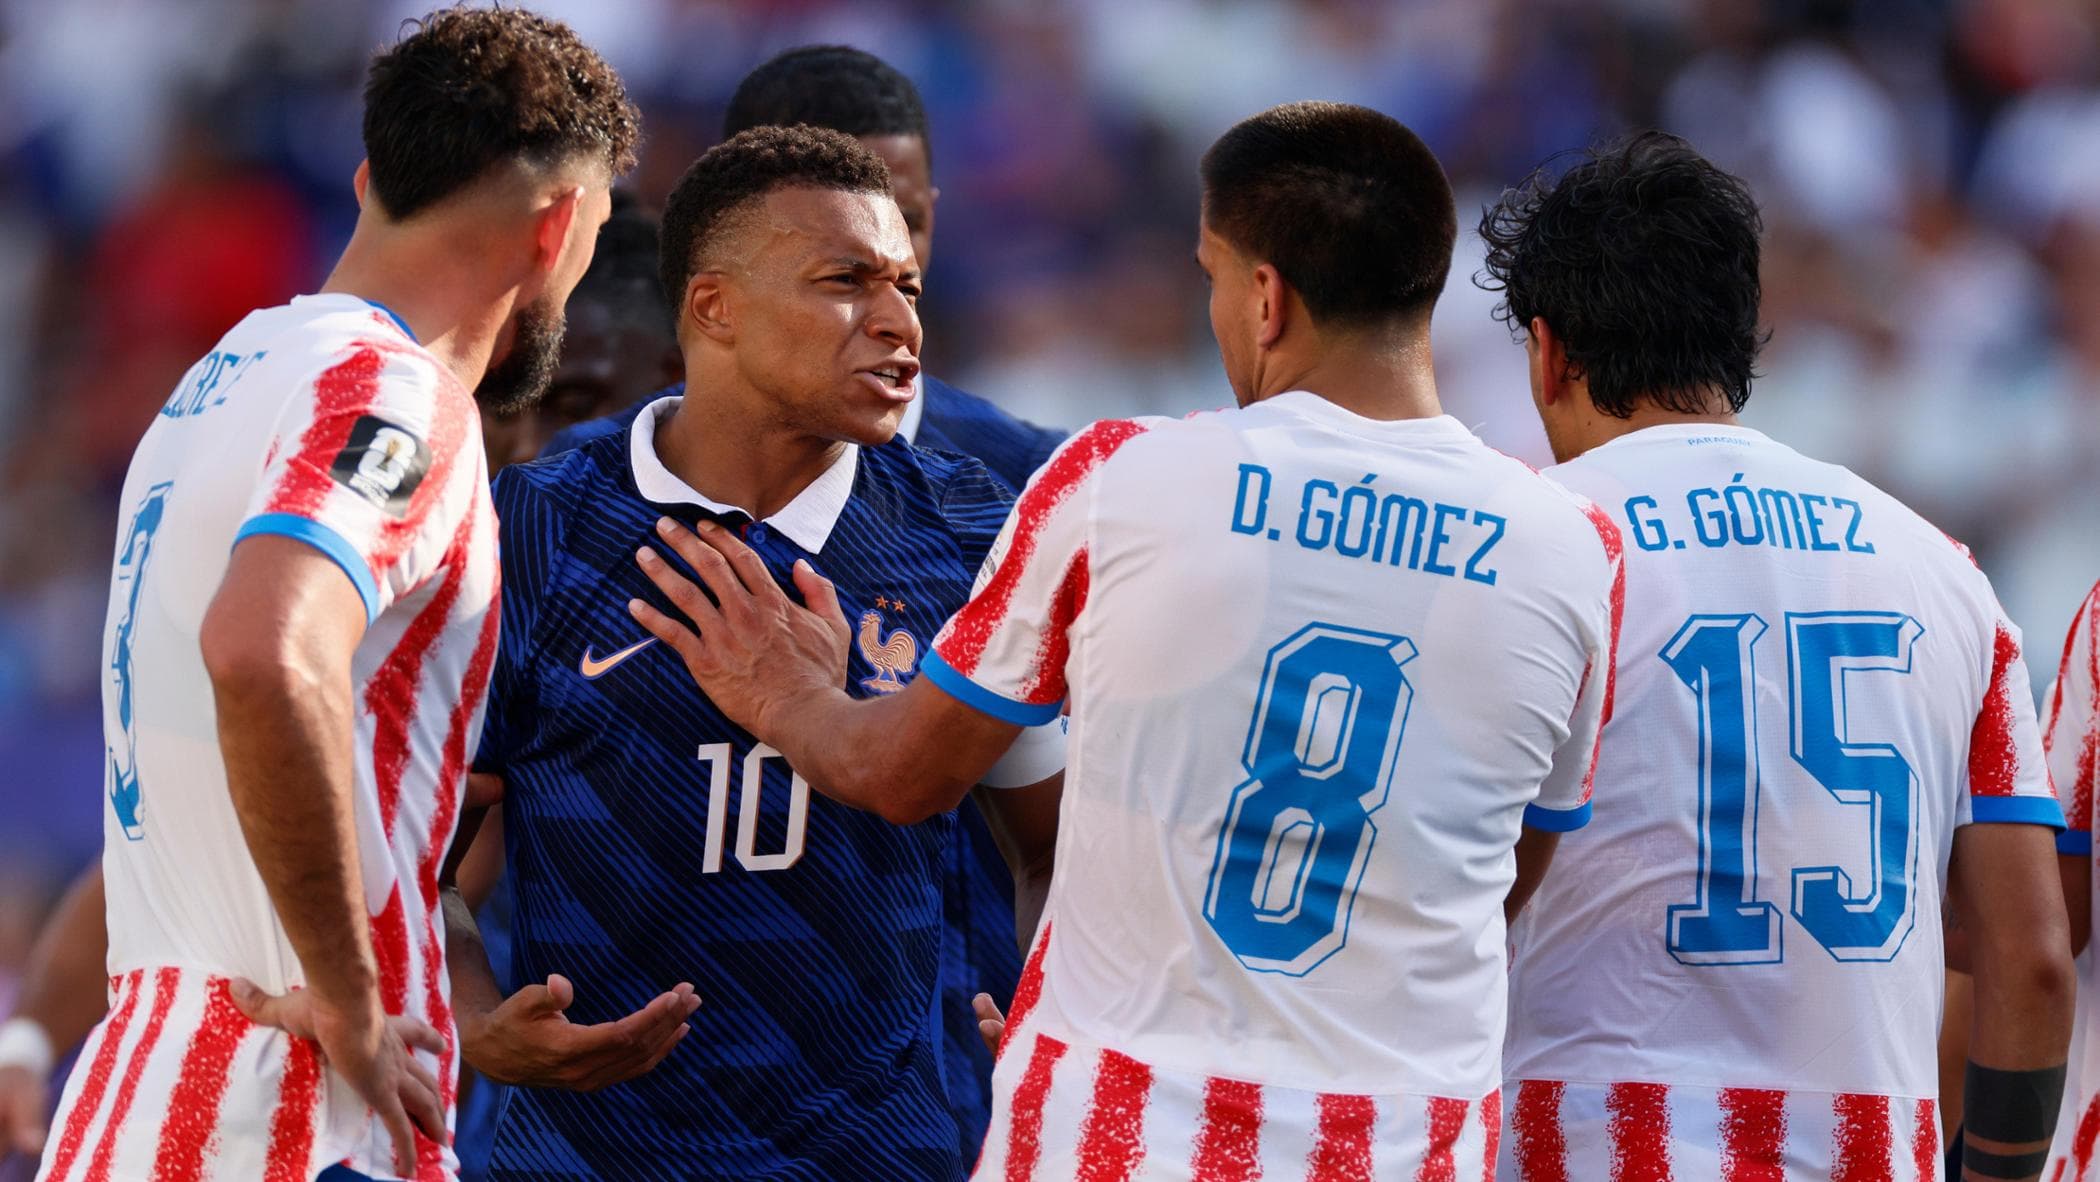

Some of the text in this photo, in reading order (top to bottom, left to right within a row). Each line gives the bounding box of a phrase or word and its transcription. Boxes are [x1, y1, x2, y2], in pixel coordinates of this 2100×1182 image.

[1230, 463, 1507, 586] D. GÓMEZ
[1624, 473, 1876, 554] G. GÓMEZ
[698, 742, 811, 874] 10
[1202, 621, 1419, 978] 8
[1657, 611, 1925, 966] 15
